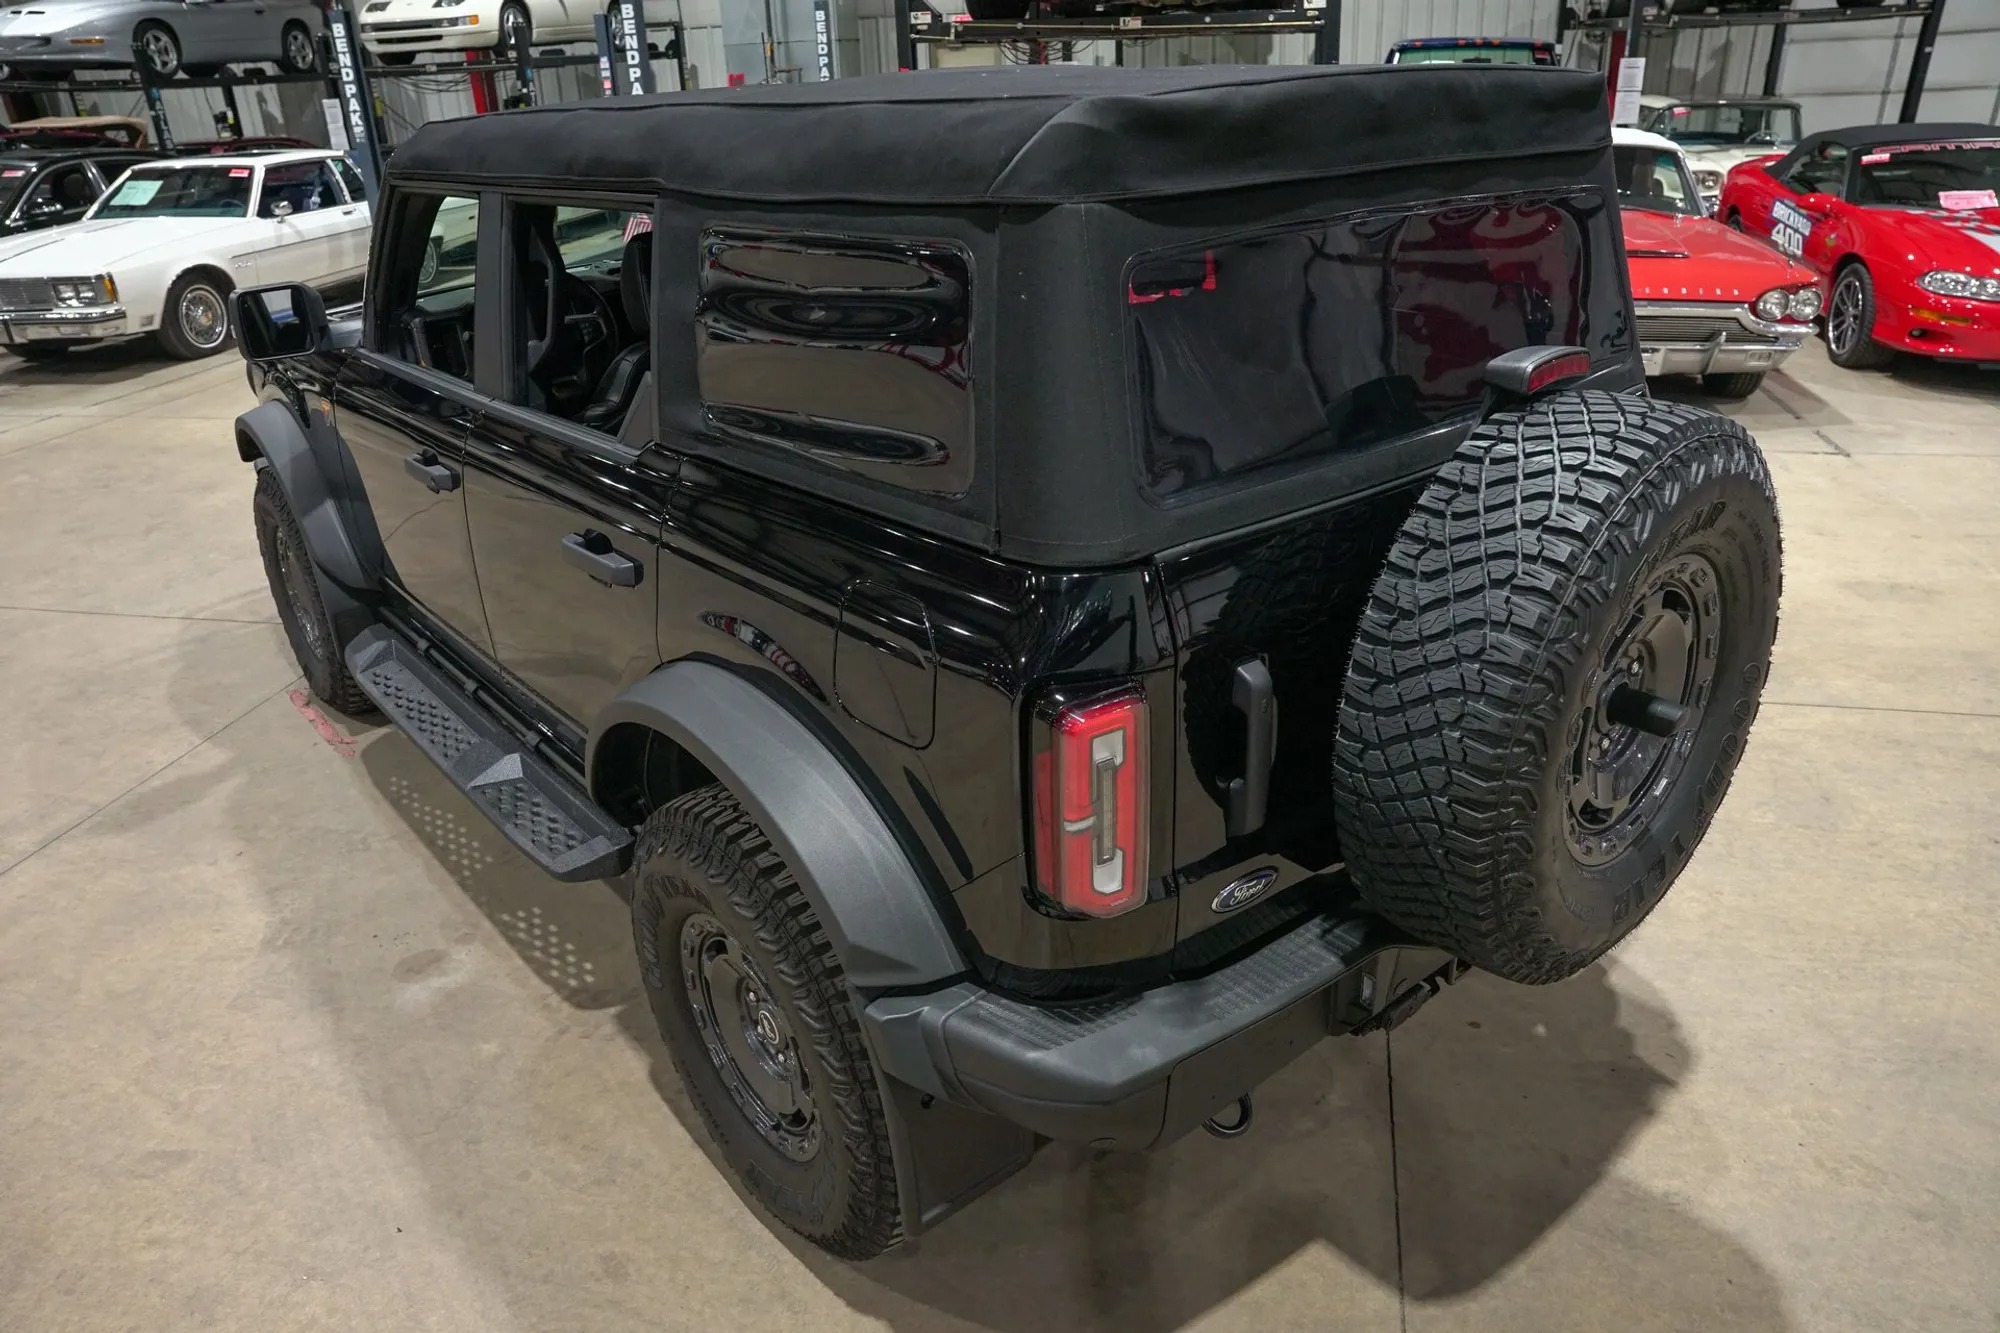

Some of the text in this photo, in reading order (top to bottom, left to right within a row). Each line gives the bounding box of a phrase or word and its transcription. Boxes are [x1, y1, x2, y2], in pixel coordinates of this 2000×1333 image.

[332, 23, 363, 126] BENDPAK
[621, 4, 644, 95] BENDPA
[815, 10, 830, 81] BENDPA
[1770, 223, 1803, 257] 400
